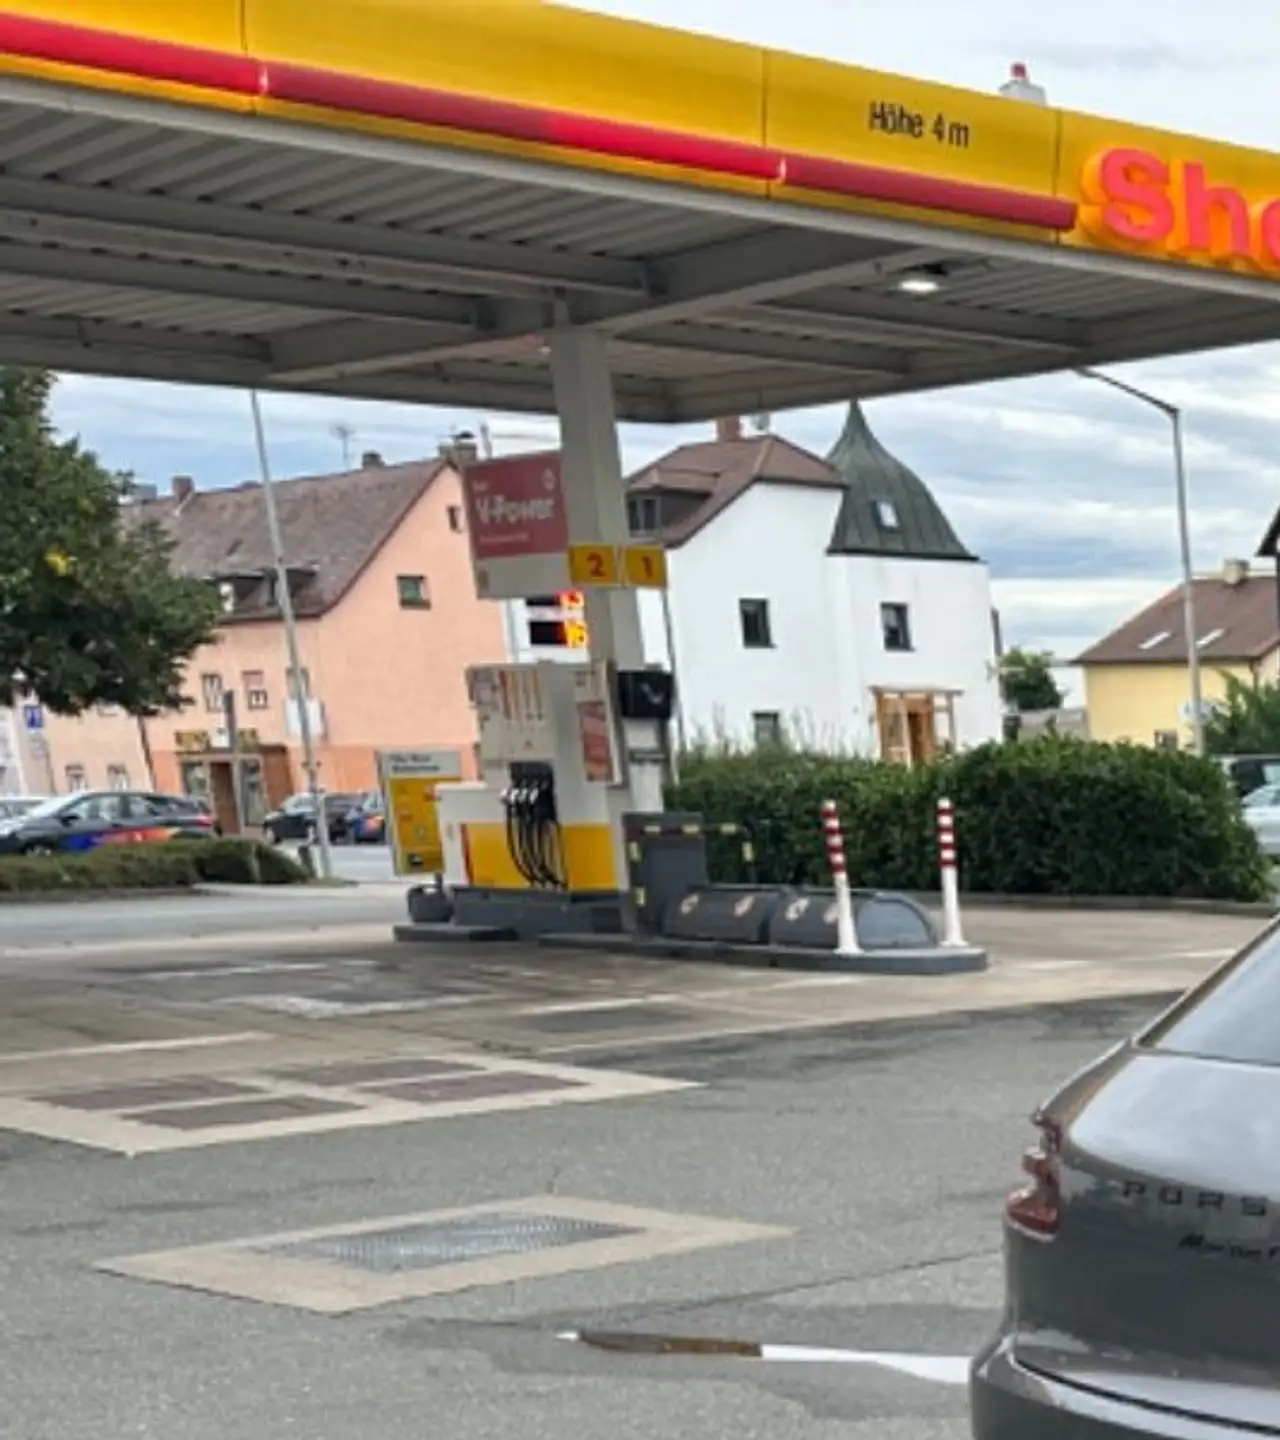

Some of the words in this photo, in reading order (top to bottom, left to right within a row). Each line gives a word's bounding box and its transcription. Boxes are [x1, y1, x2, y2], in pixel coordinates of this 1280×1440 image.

[868, 100, 923, 138] Höhe
[586, 551, 606, 579] 2
[643, 555, 654, 580] 1
